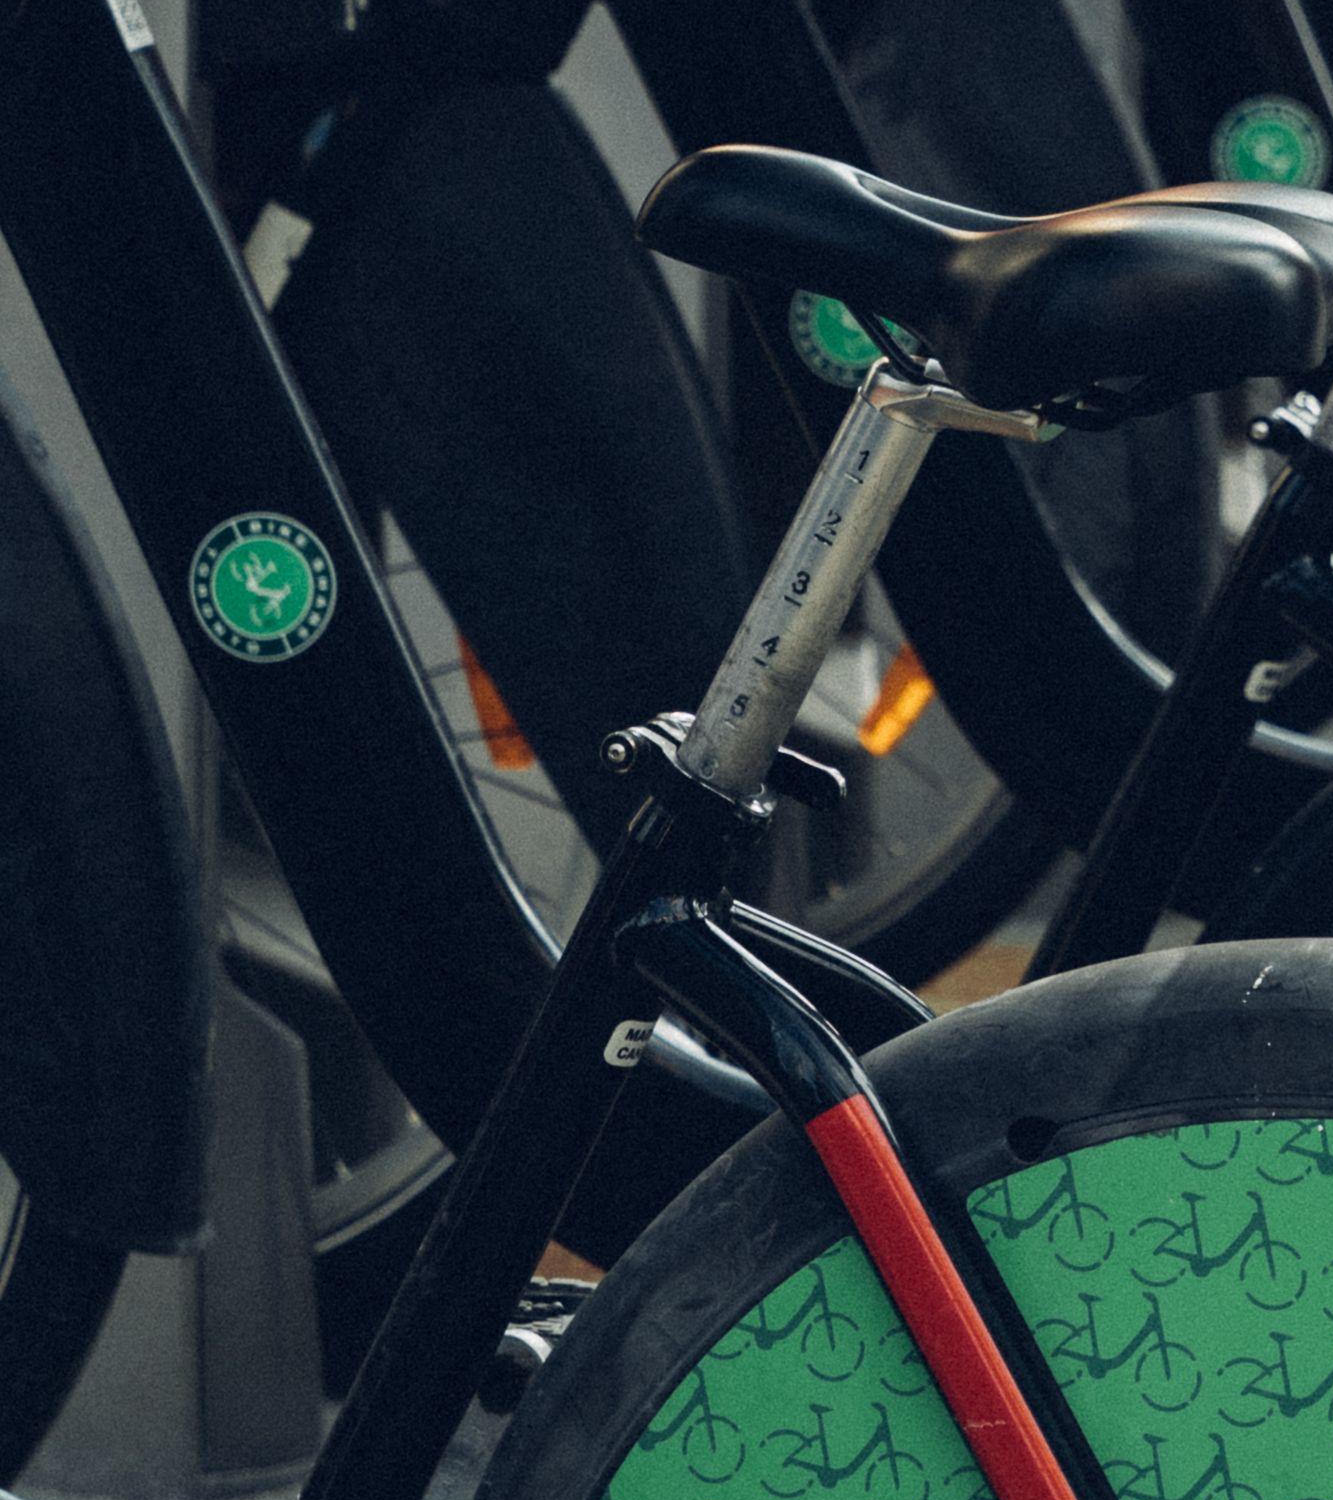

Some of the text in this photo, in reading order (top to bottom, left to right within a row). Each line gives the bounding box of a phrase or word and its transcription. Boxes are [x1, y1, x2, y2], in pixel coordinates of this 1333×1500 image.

[857, 449, 871, 472] 1
[791, 570, 811, 596] 3
[760, 635, 781, 658] 4
[729, 693, 750, 718] 5
